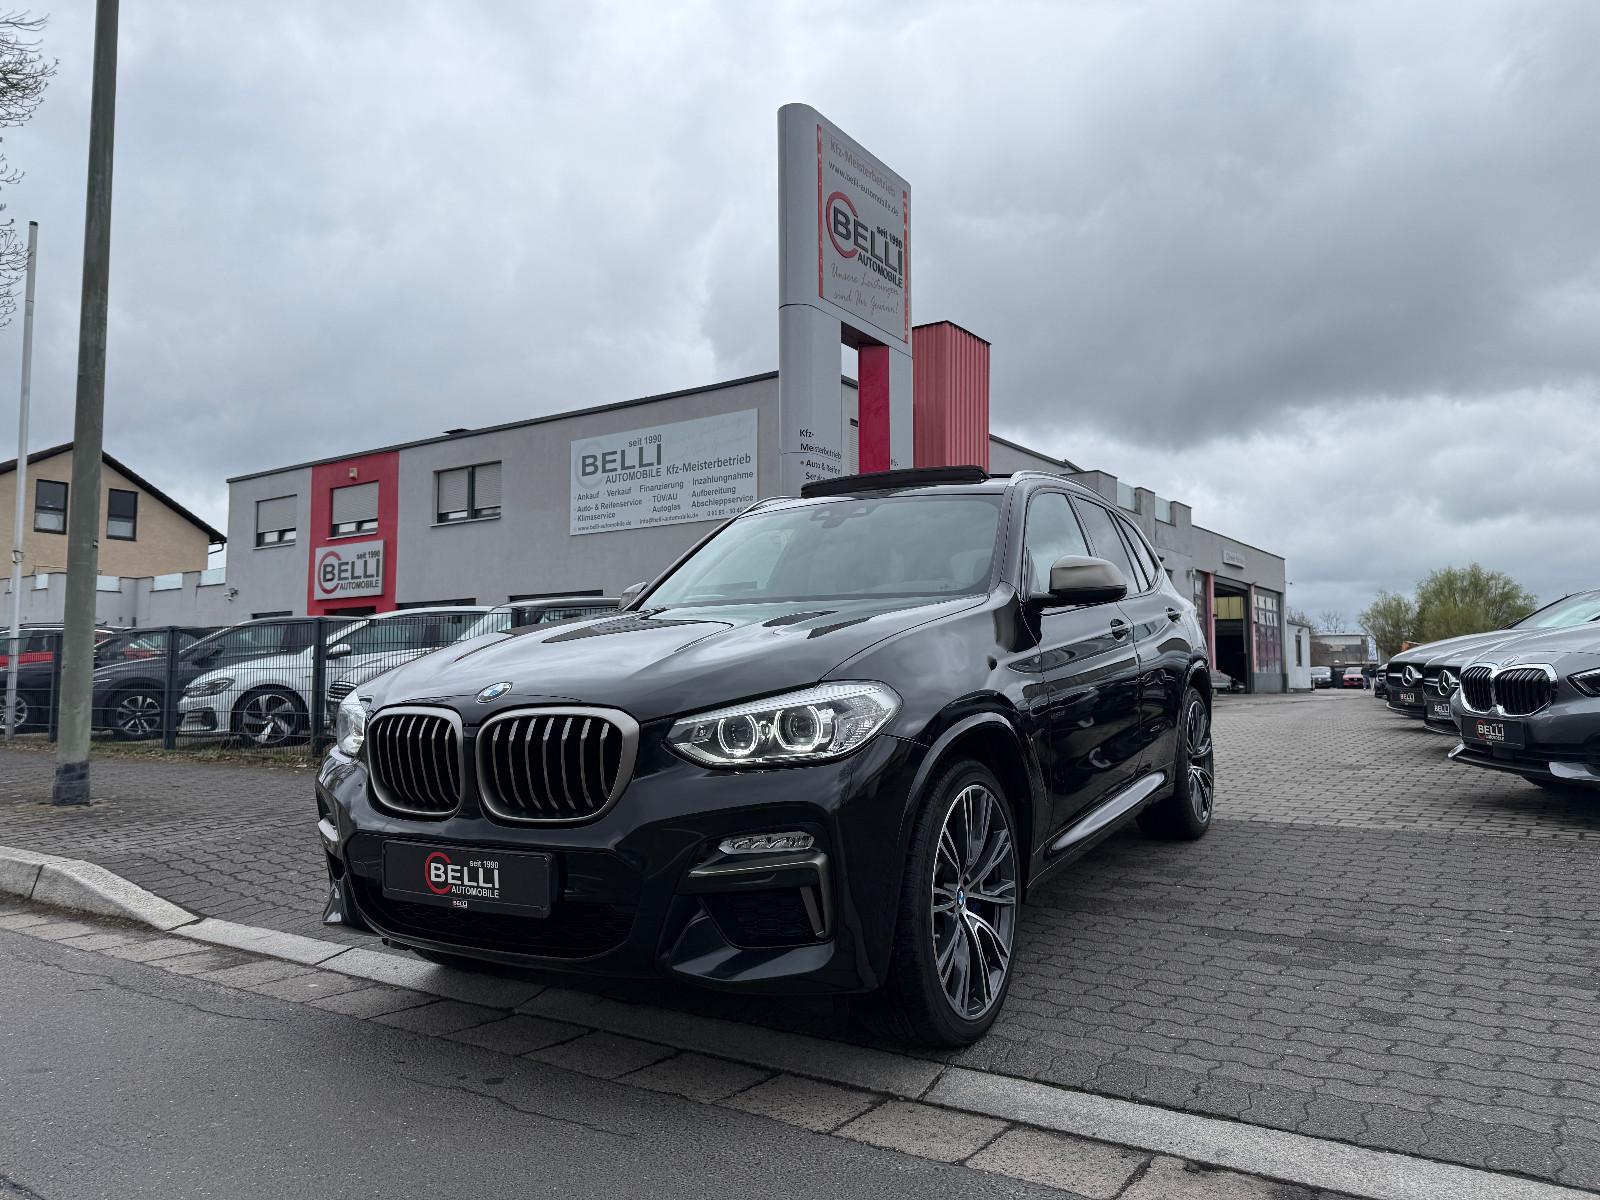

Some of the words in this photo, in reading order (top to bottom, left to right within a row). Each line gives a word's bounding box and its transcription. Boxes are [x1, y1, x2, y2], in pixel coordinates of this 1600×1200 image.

[830, 137, 896, 197] Kfz-Meisterbetrieb
[833, 206, 903, 276] BELLI
[857, 251, 903, 288] AUTOMOBILE
[800, 429, 815, 438] Kfz-
[628, 438, 642, 448] seit
[645, 434, 662, 445] 1990
[581, 443, 662, 477] BELLI
[666, 453, 751, 476] Kfz-Meisterbetrieb
[605, 467, 662, 485] AUTOMOBILE
[692, 471, 754, 487] Inzahlungnahme
[606, 487, 632, 497] Verkauf
[639, 480, 684, 494] Finanzierung
[691, 486, 736, 499] Aufbereitung
[577, 490, 600, 501] Ankauf
[652, 493, 678, 503] TÜV/AU
[691, 494, 754, 509] Abschleppservice
[577, 504, 593, 513] Auto-
[594, 503, 599, 511] &
[601, 499, 643, 510] Reifenservice
[652, 503, 681, 514] Autoglas
[577, 512, 616, 523] Klimaservice
[357, 551, 367, 560] seit
[323, 558, 380, 583] BELLI
[339, 579, 380, 591] AUTOMOBILE
[1477, 724, 1504, 737] BELLI
[470, 859, 481, 868] seit
[483, 860, 499, 869] 1990
[430, 862, 500, 889] BELLI
[451, 885, 500, 899] AUTOMOBILE
